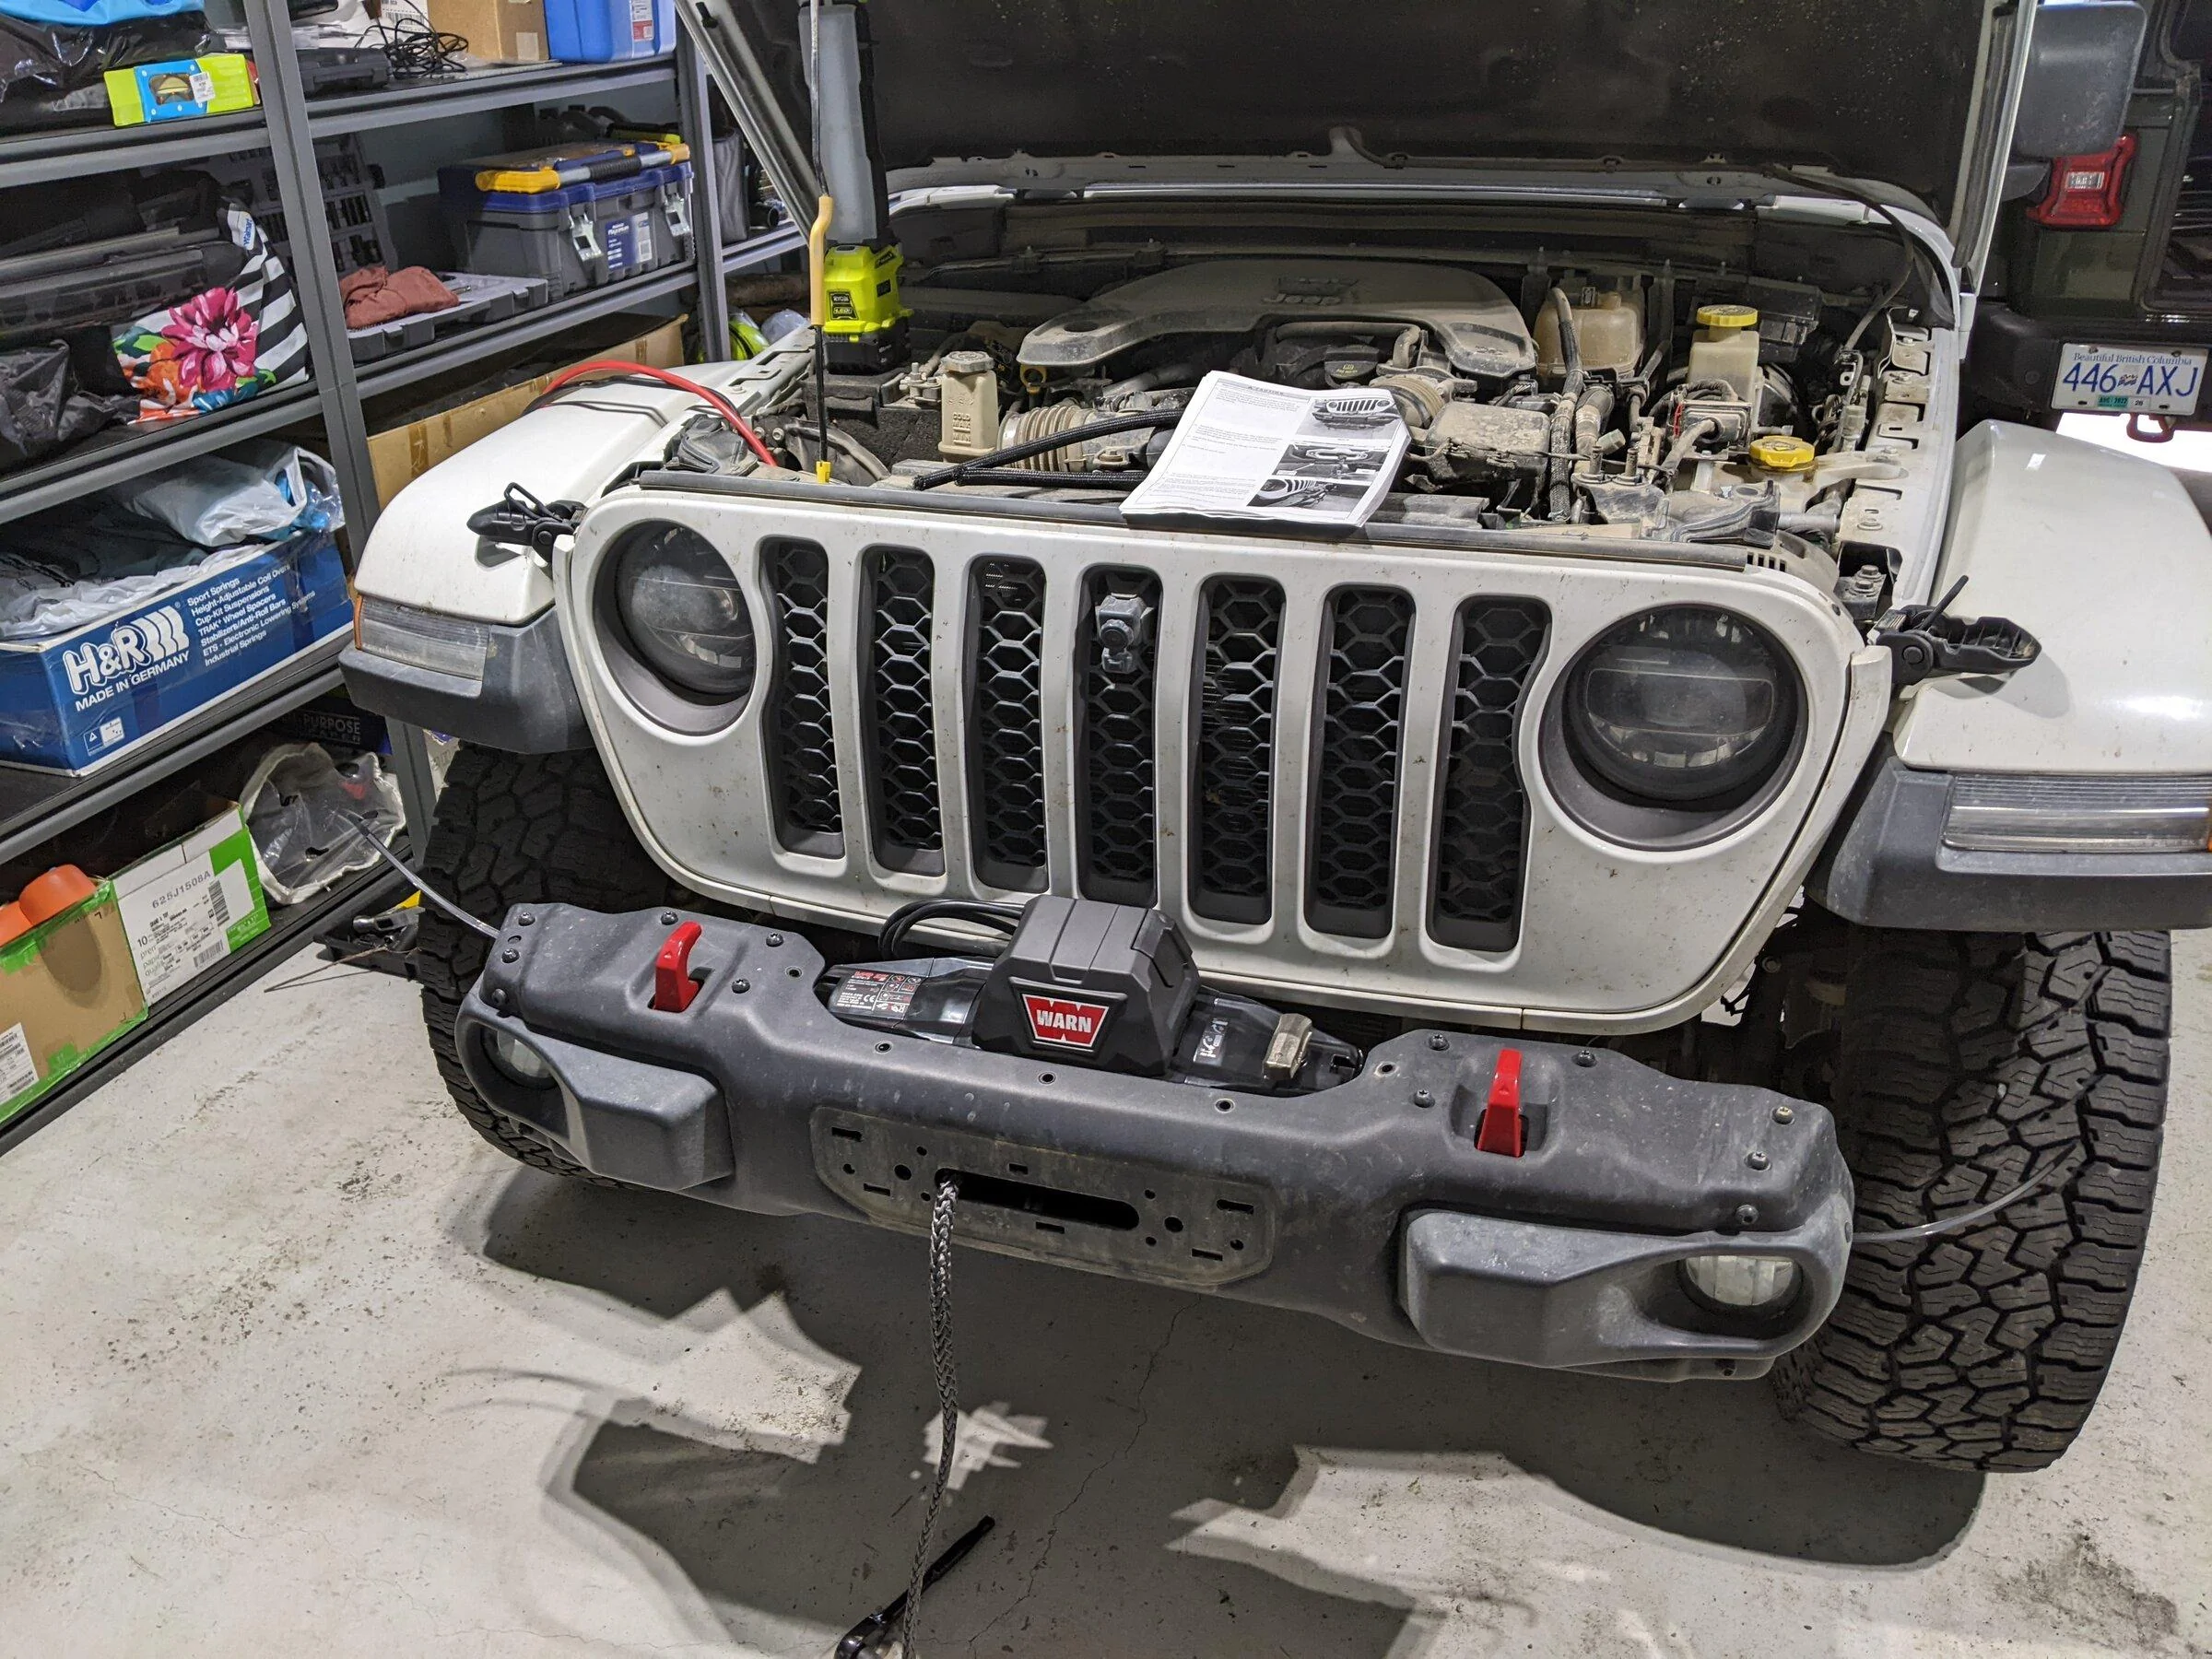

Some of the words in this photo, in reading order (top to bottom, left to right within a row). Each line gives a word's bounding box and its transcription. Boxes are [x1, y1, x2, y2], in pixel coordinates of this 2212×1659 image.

[2074, 352, 2114, 362] Beautiful
[2116, 354, 2145, 364] British
[2147, 355, 2192, 366] Columbia
[2063, 362, 2118, 393] 446
[2136, 365, 2198, 396] AXJ
[187, 591, 210, 606] Sport
[210, 578, 240, 597] Springs
[191, 582, 257, 617] Height-Adjustable
[257, 574, 272, 585] Coil
[195, 607, 223, 627] Cup-Kit
[223, 585, 270, 612] Suspensions
[222, 607, 246, 624] Wheel
[246, 593, 276, 612] Spacers
[269, 598, 287, 609] Bars
[203, 643, 218, 656] ETS
[224, 623, 259, 646] Electronic
[260, 606, 292, 628] Lowering
[204, 645, 239, 666] Industrial
[240, 629, 267, 650] Springs
[64, 626, 150, 694] H&R
[76, 686, 114, 712] MADE
[115, 678, 129, 693] IN
[130, 651, 189, 686] GERMANY
[303, 713, 360, 735] PURPOSE
[152, 871, 211, 909] 625J1508A
[1036, 1009, 1091, 1033] WARN
